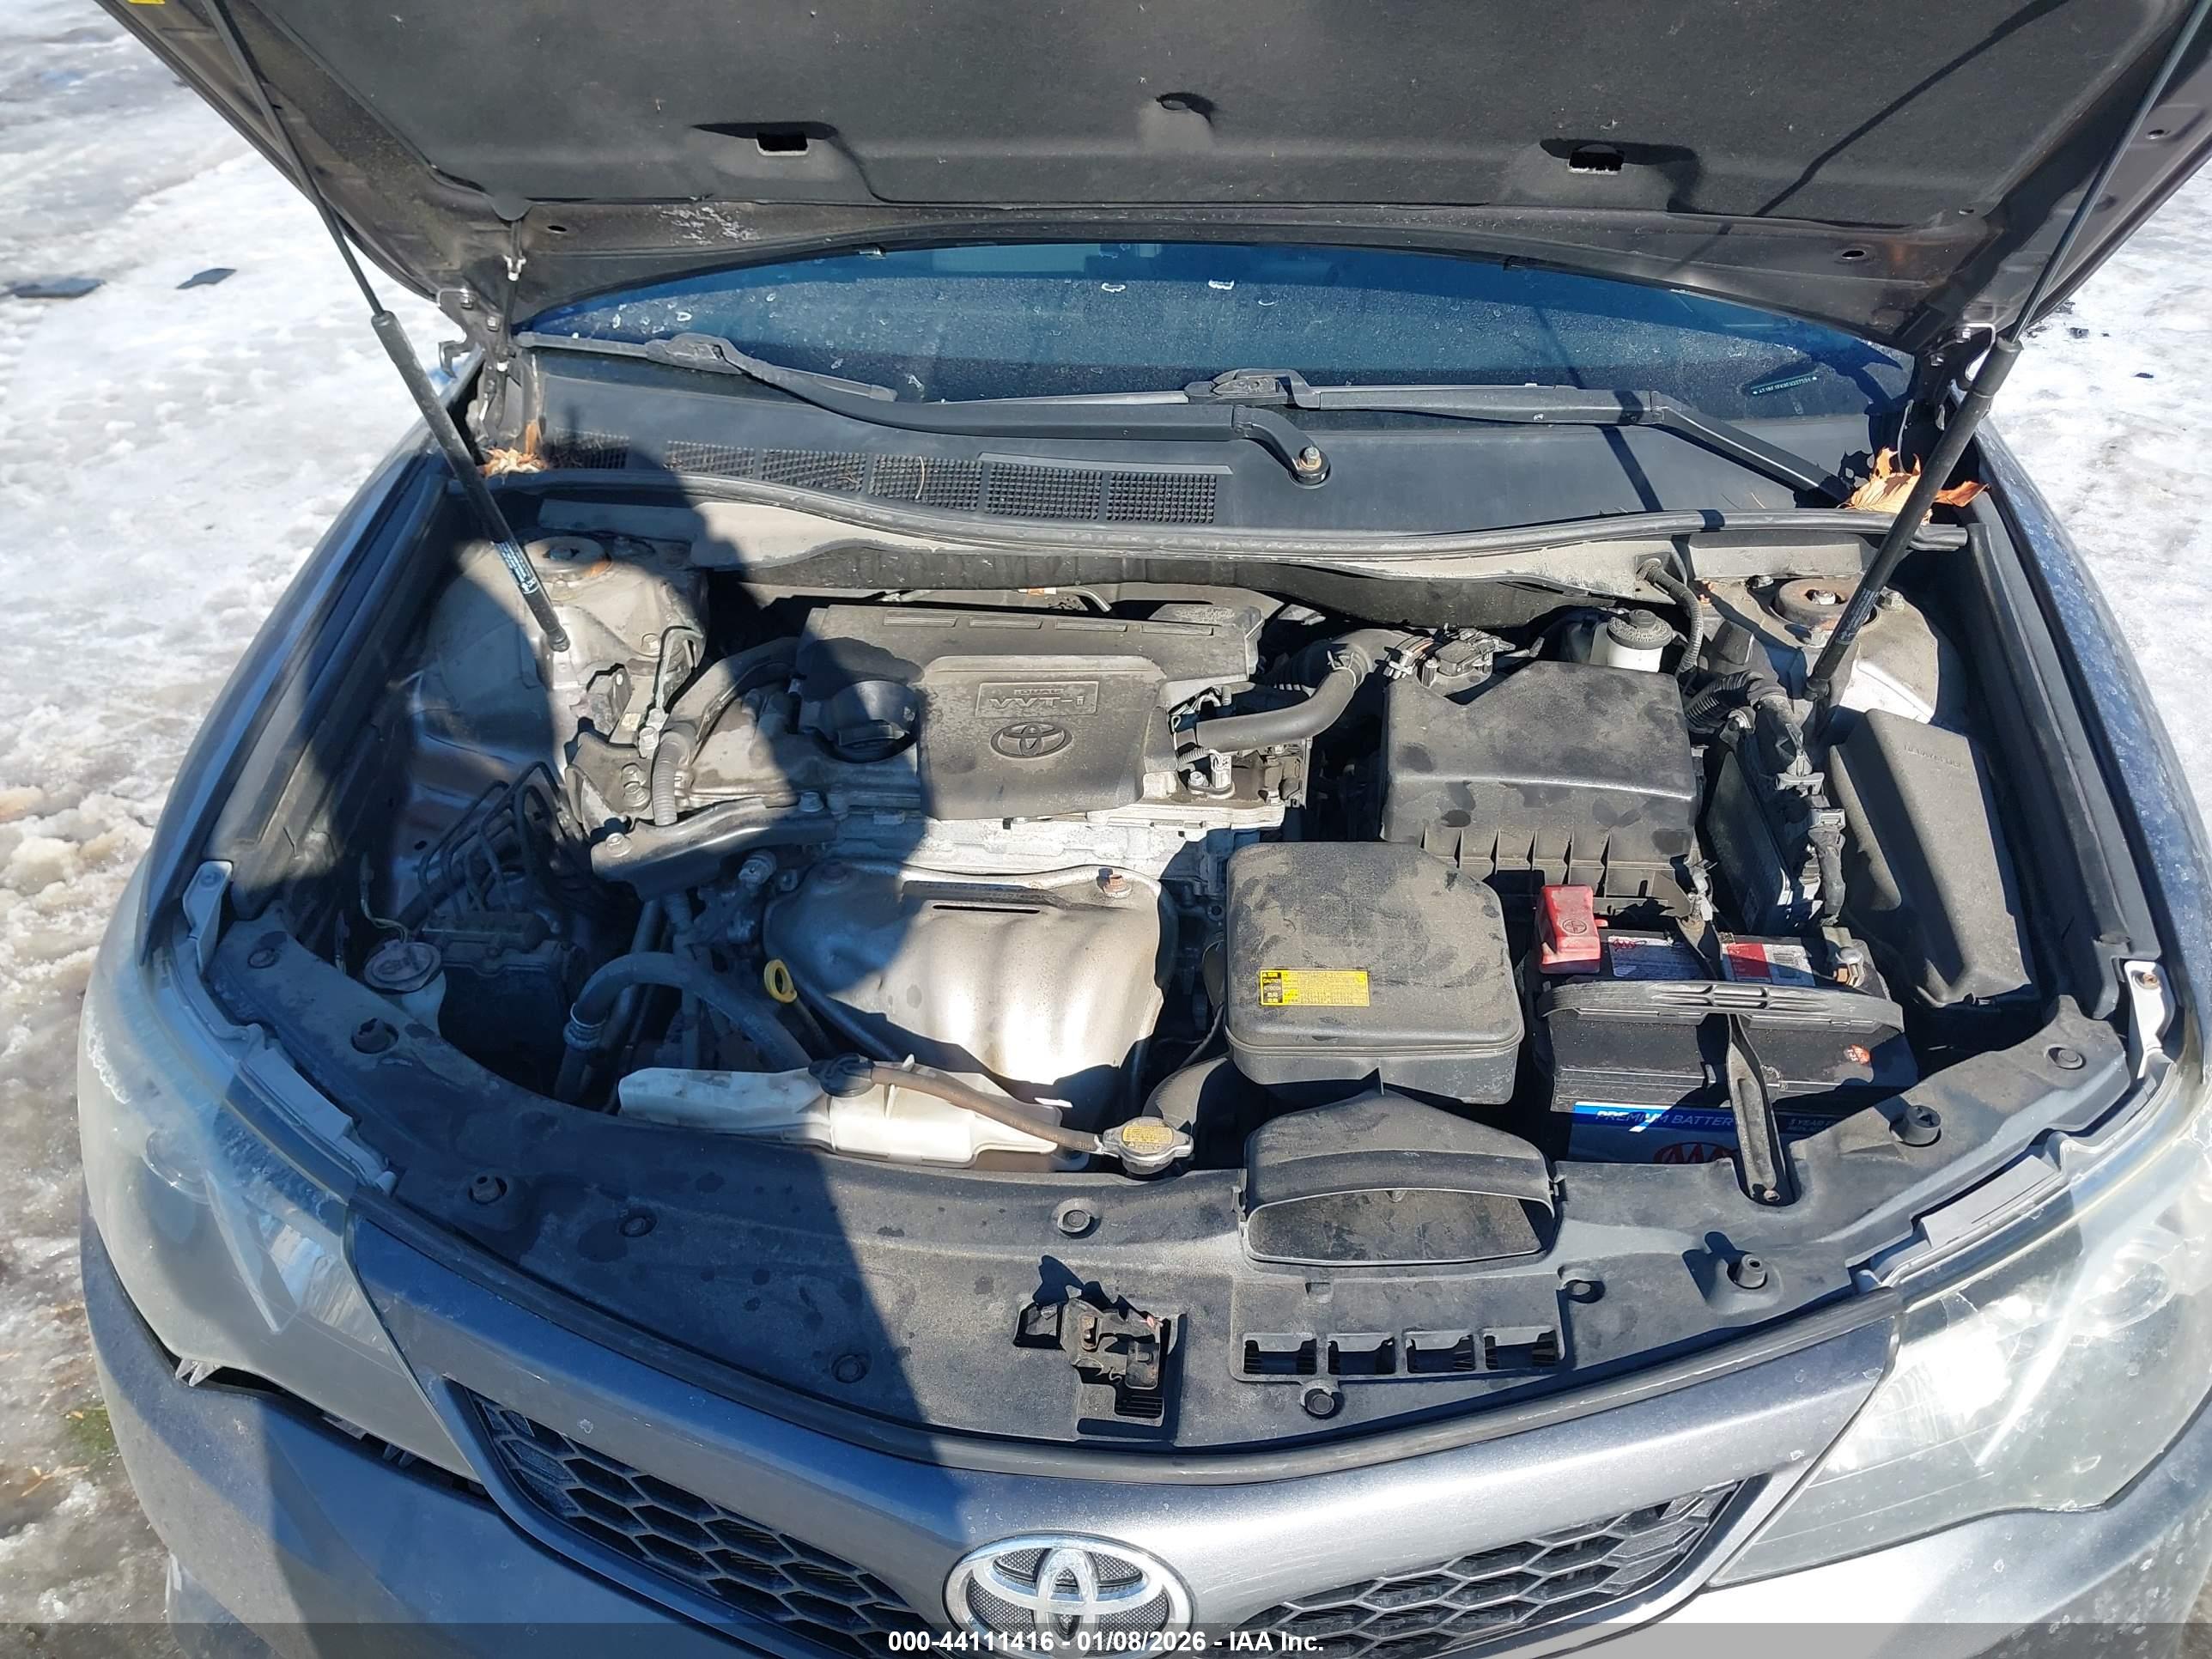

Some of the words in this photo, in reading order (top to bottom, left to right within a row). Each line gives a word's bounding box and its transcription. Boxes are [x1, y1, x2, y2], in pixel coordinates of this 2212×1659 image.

[989, 696, 1085, 708] VVT-i
[1595, 1110, 1669, 1123] PREMIUM
[1672, 1114, 1734, 1127] BATTER
